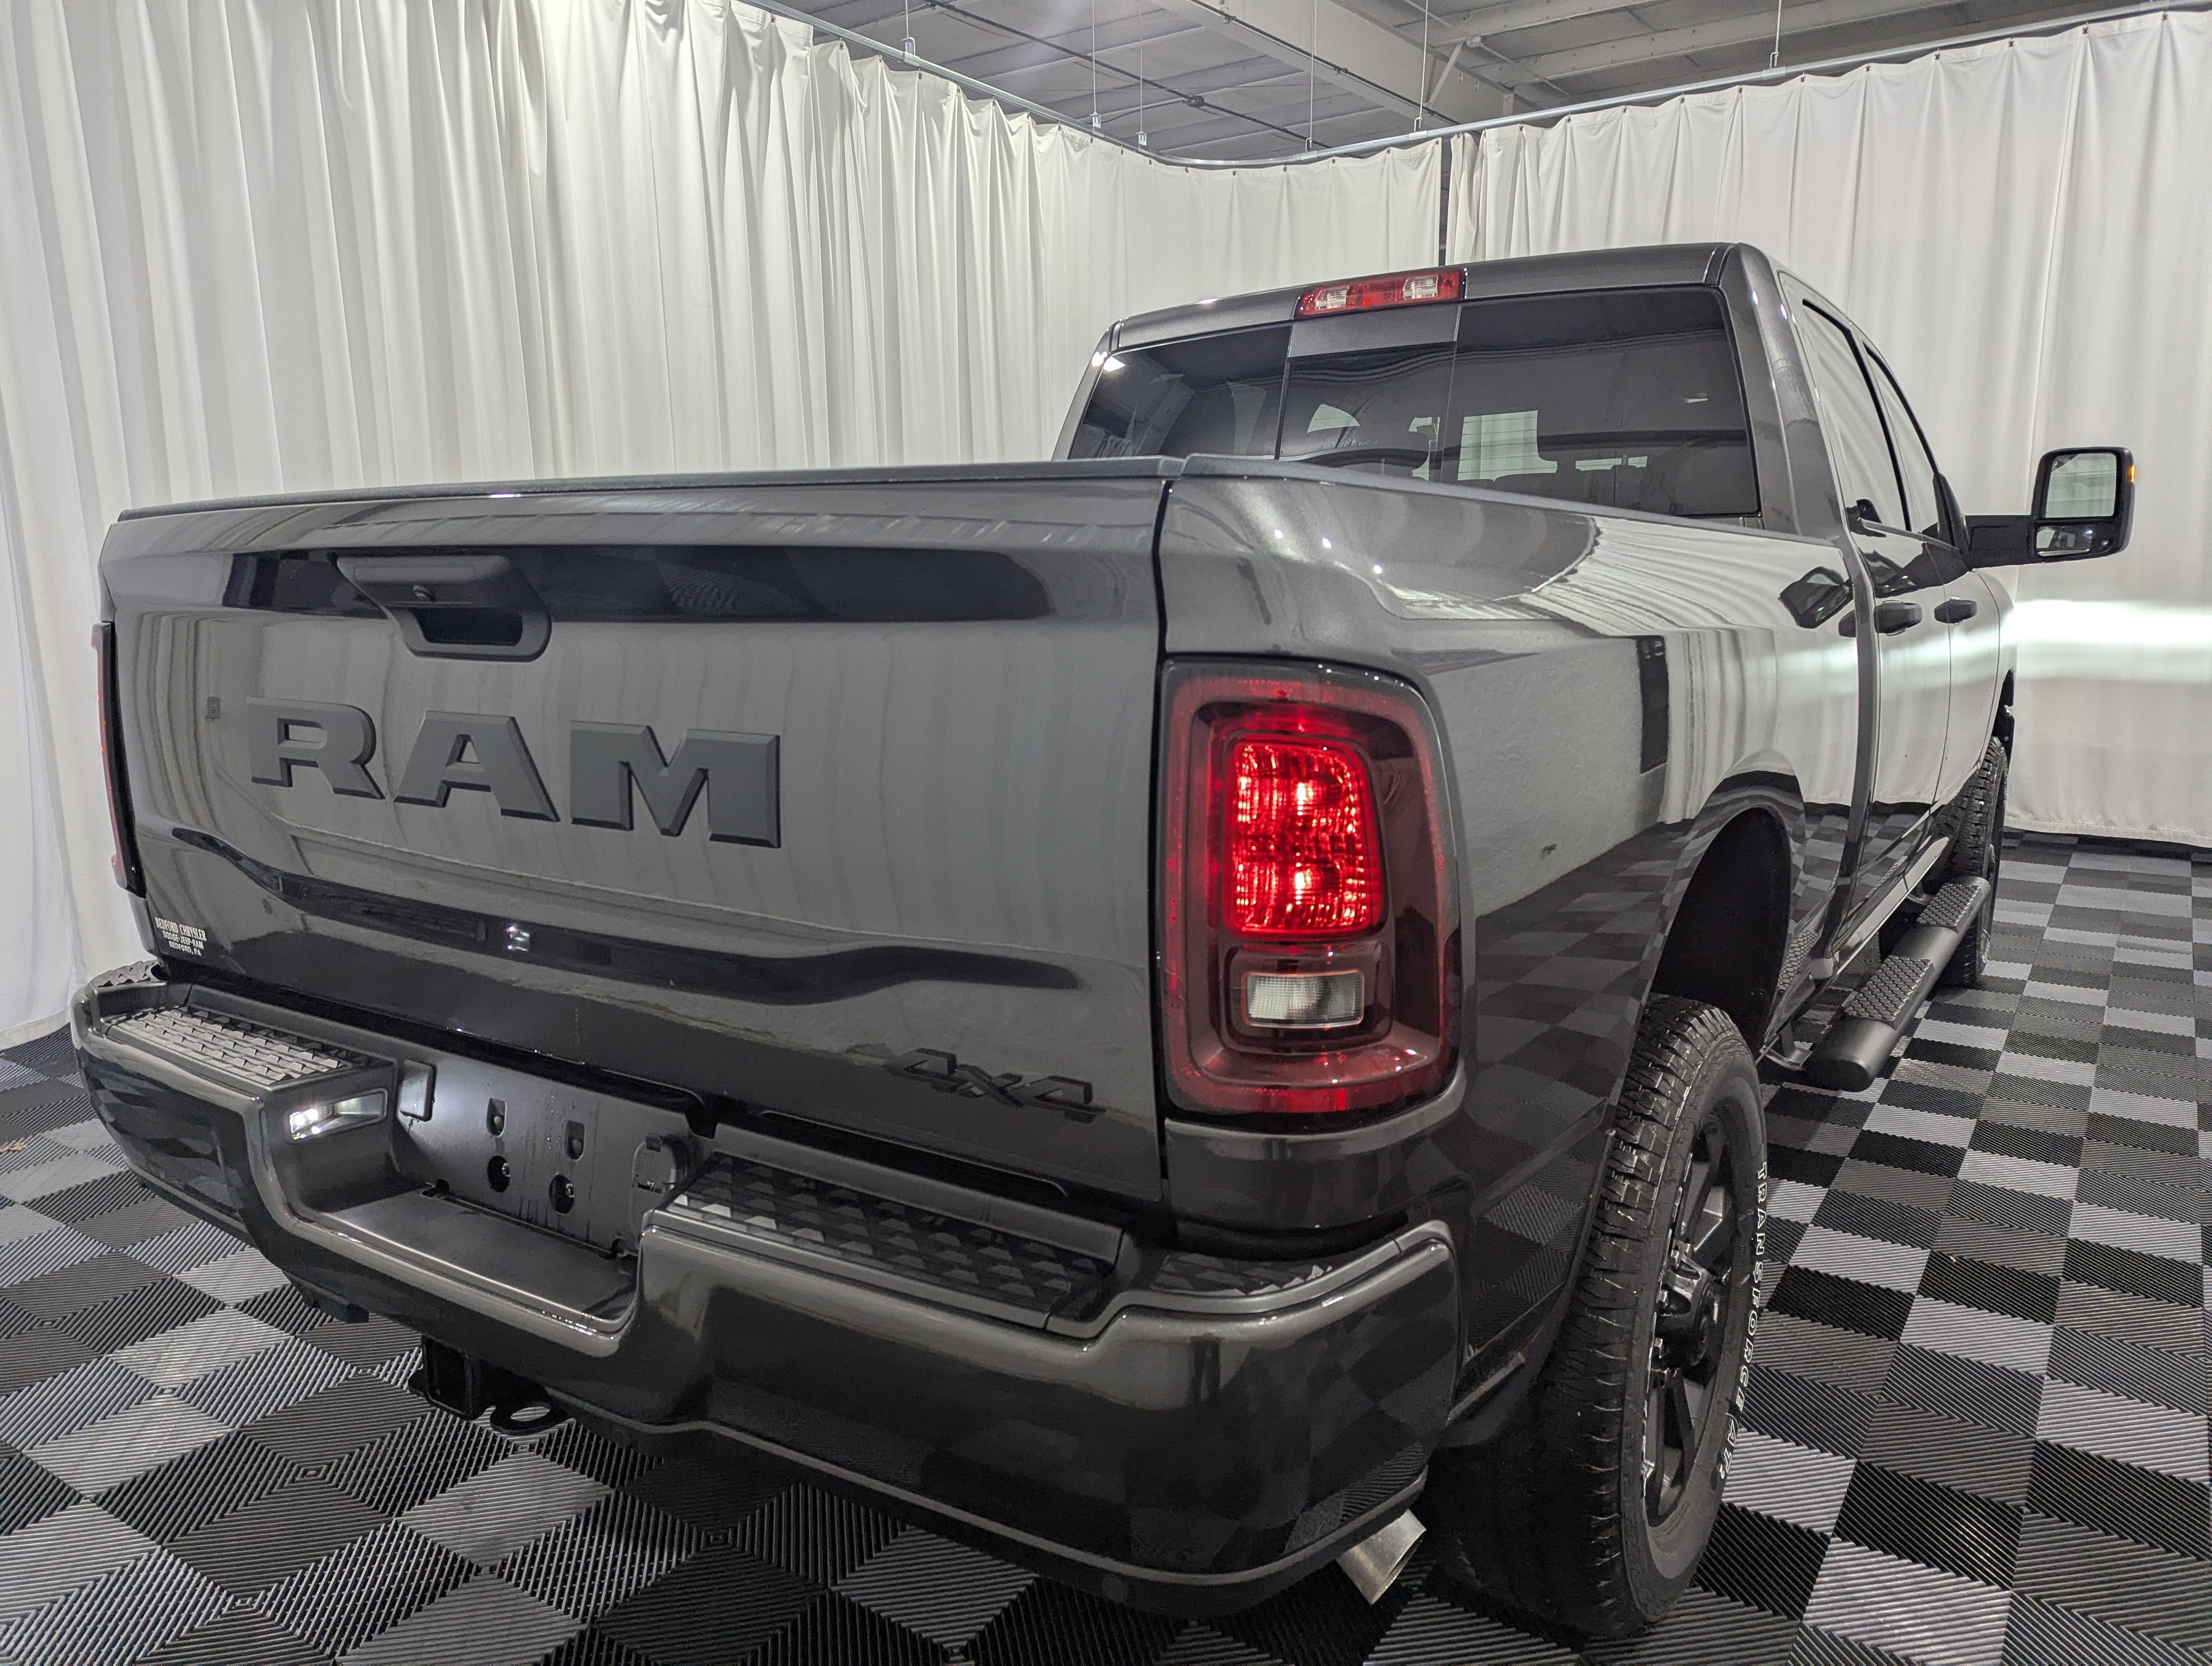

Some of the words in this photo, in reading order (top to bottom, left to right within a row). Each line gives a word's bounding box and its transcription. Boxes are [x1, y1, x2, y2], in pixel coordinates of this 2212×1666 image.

[246, 696, 782, 849] RAM
[155, 917, 178, 933] BEDFORD
[179, 924, 207, 942] CHRYSLER
[169, 940, 194, 955] BEDFORD,
[194, 948, 202, 957] PA
[882, 1048, 1107, 1124] 4X4
[1735, 1161, 1767, 1412] TRANSFORCE
